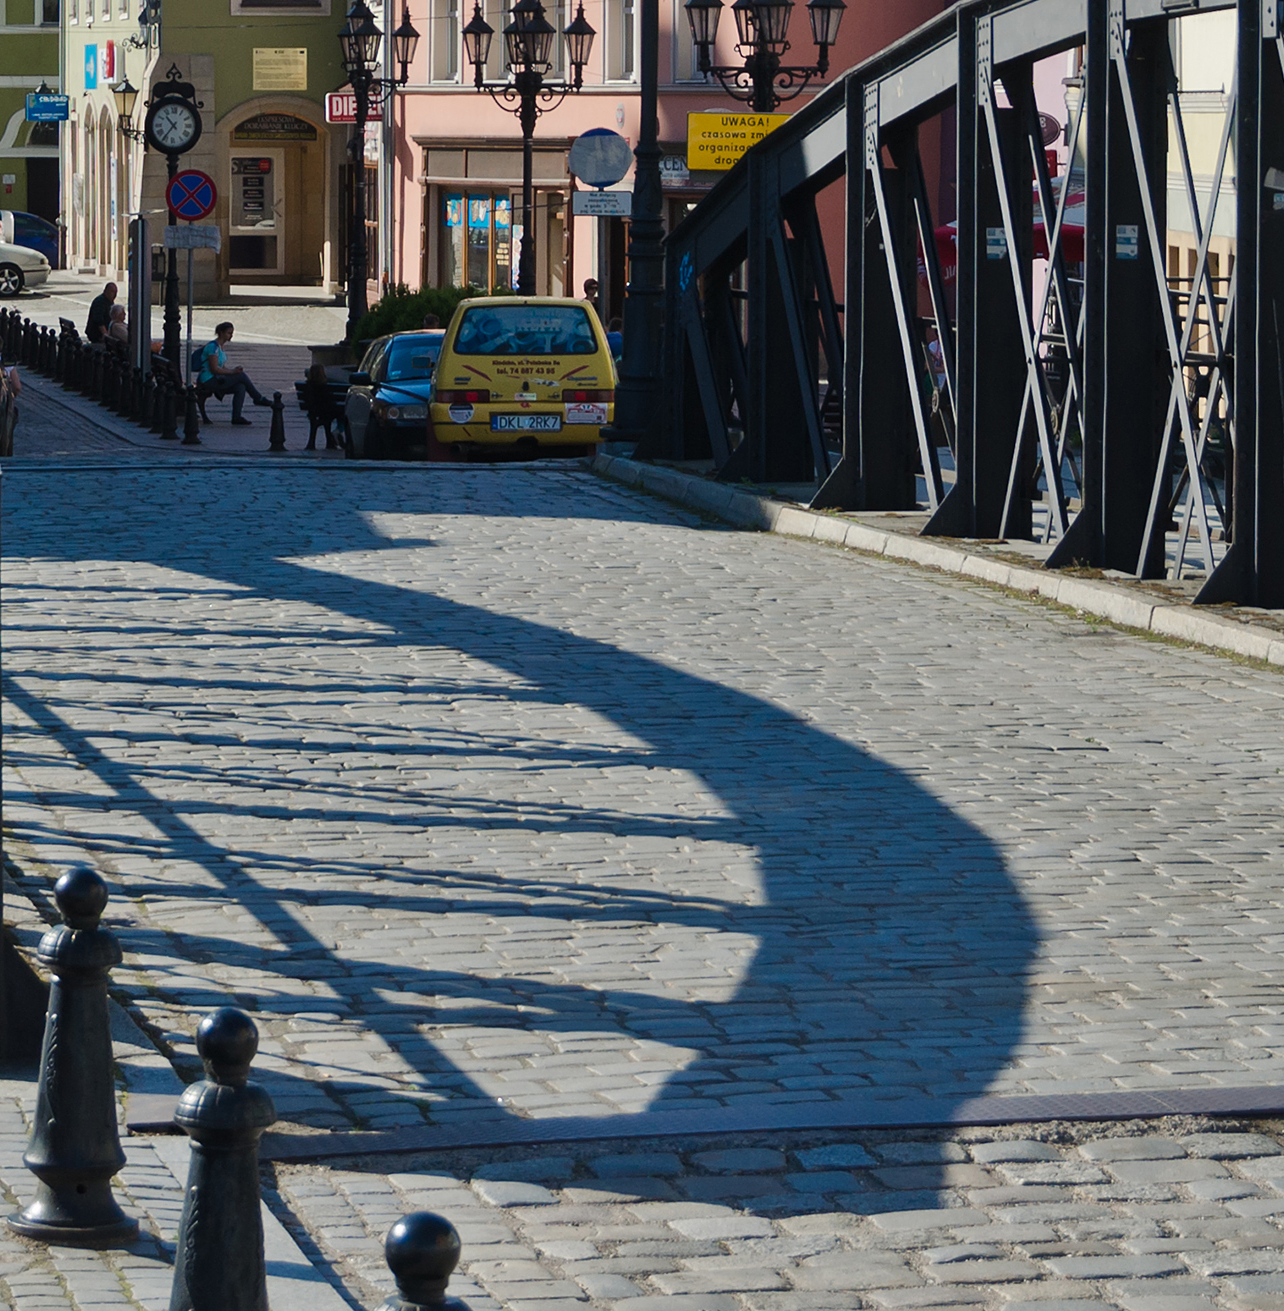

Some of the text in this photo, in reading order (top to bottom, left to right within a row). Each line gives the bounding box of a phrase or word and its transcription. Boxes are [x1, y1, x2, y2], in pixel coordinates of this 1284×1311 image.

[332, 96, 383, 116] DIEE
[721, 117, 770, 127] UWAGA!
[701, 131, 747, 139] czasowa
[499, 416, 559, 429] DKL 2RK7
